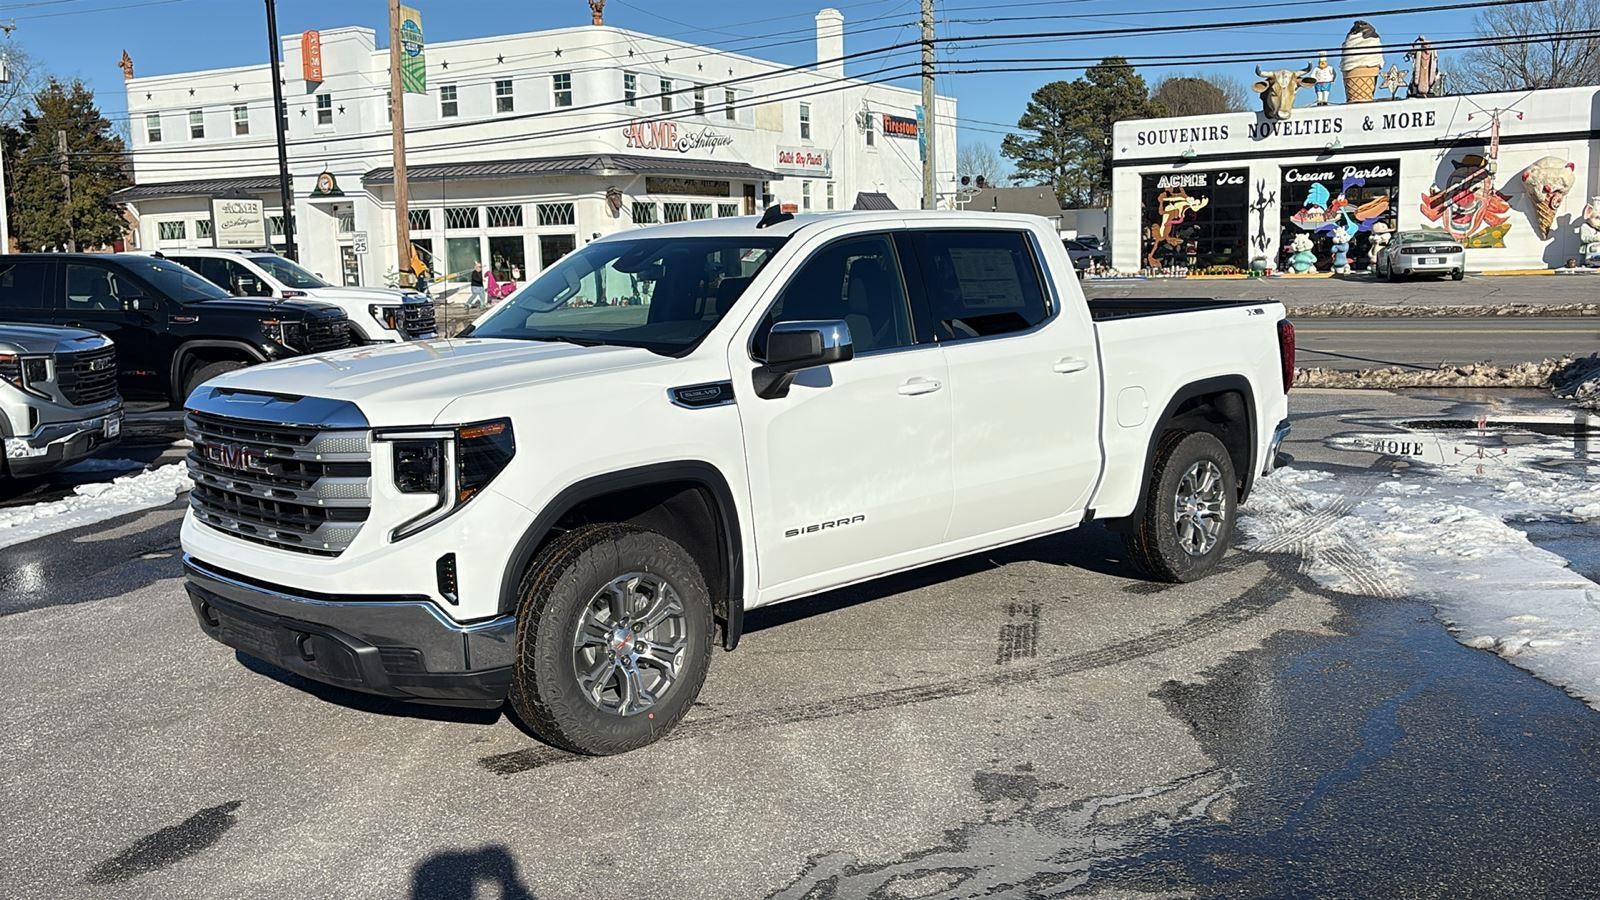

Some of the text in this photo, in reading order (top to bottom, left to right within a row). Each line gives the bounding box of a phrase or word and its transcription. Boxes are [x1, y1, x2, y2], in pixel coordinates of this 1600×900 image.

[310, 33, 321, 78] ACME
[884, 115, 918, 135] Firestone
[1137, 110, 1436, 146] SOUVENIRS NOVELTIES & MORE
[622, 118, 734, 154] ACME Antiques
[779, 150, 822, 167] Dutch Boy Paints
[1156, 172, 1245, 189] ACME Ice
[1285, 165, 1395, 182] Cream Parlor
[222, 202, 259, 214] ACME
[355, 242, 367, 252] 25
[203, 441, 272, 475] GMC
[785, 514, 866, 538] SIERRA
